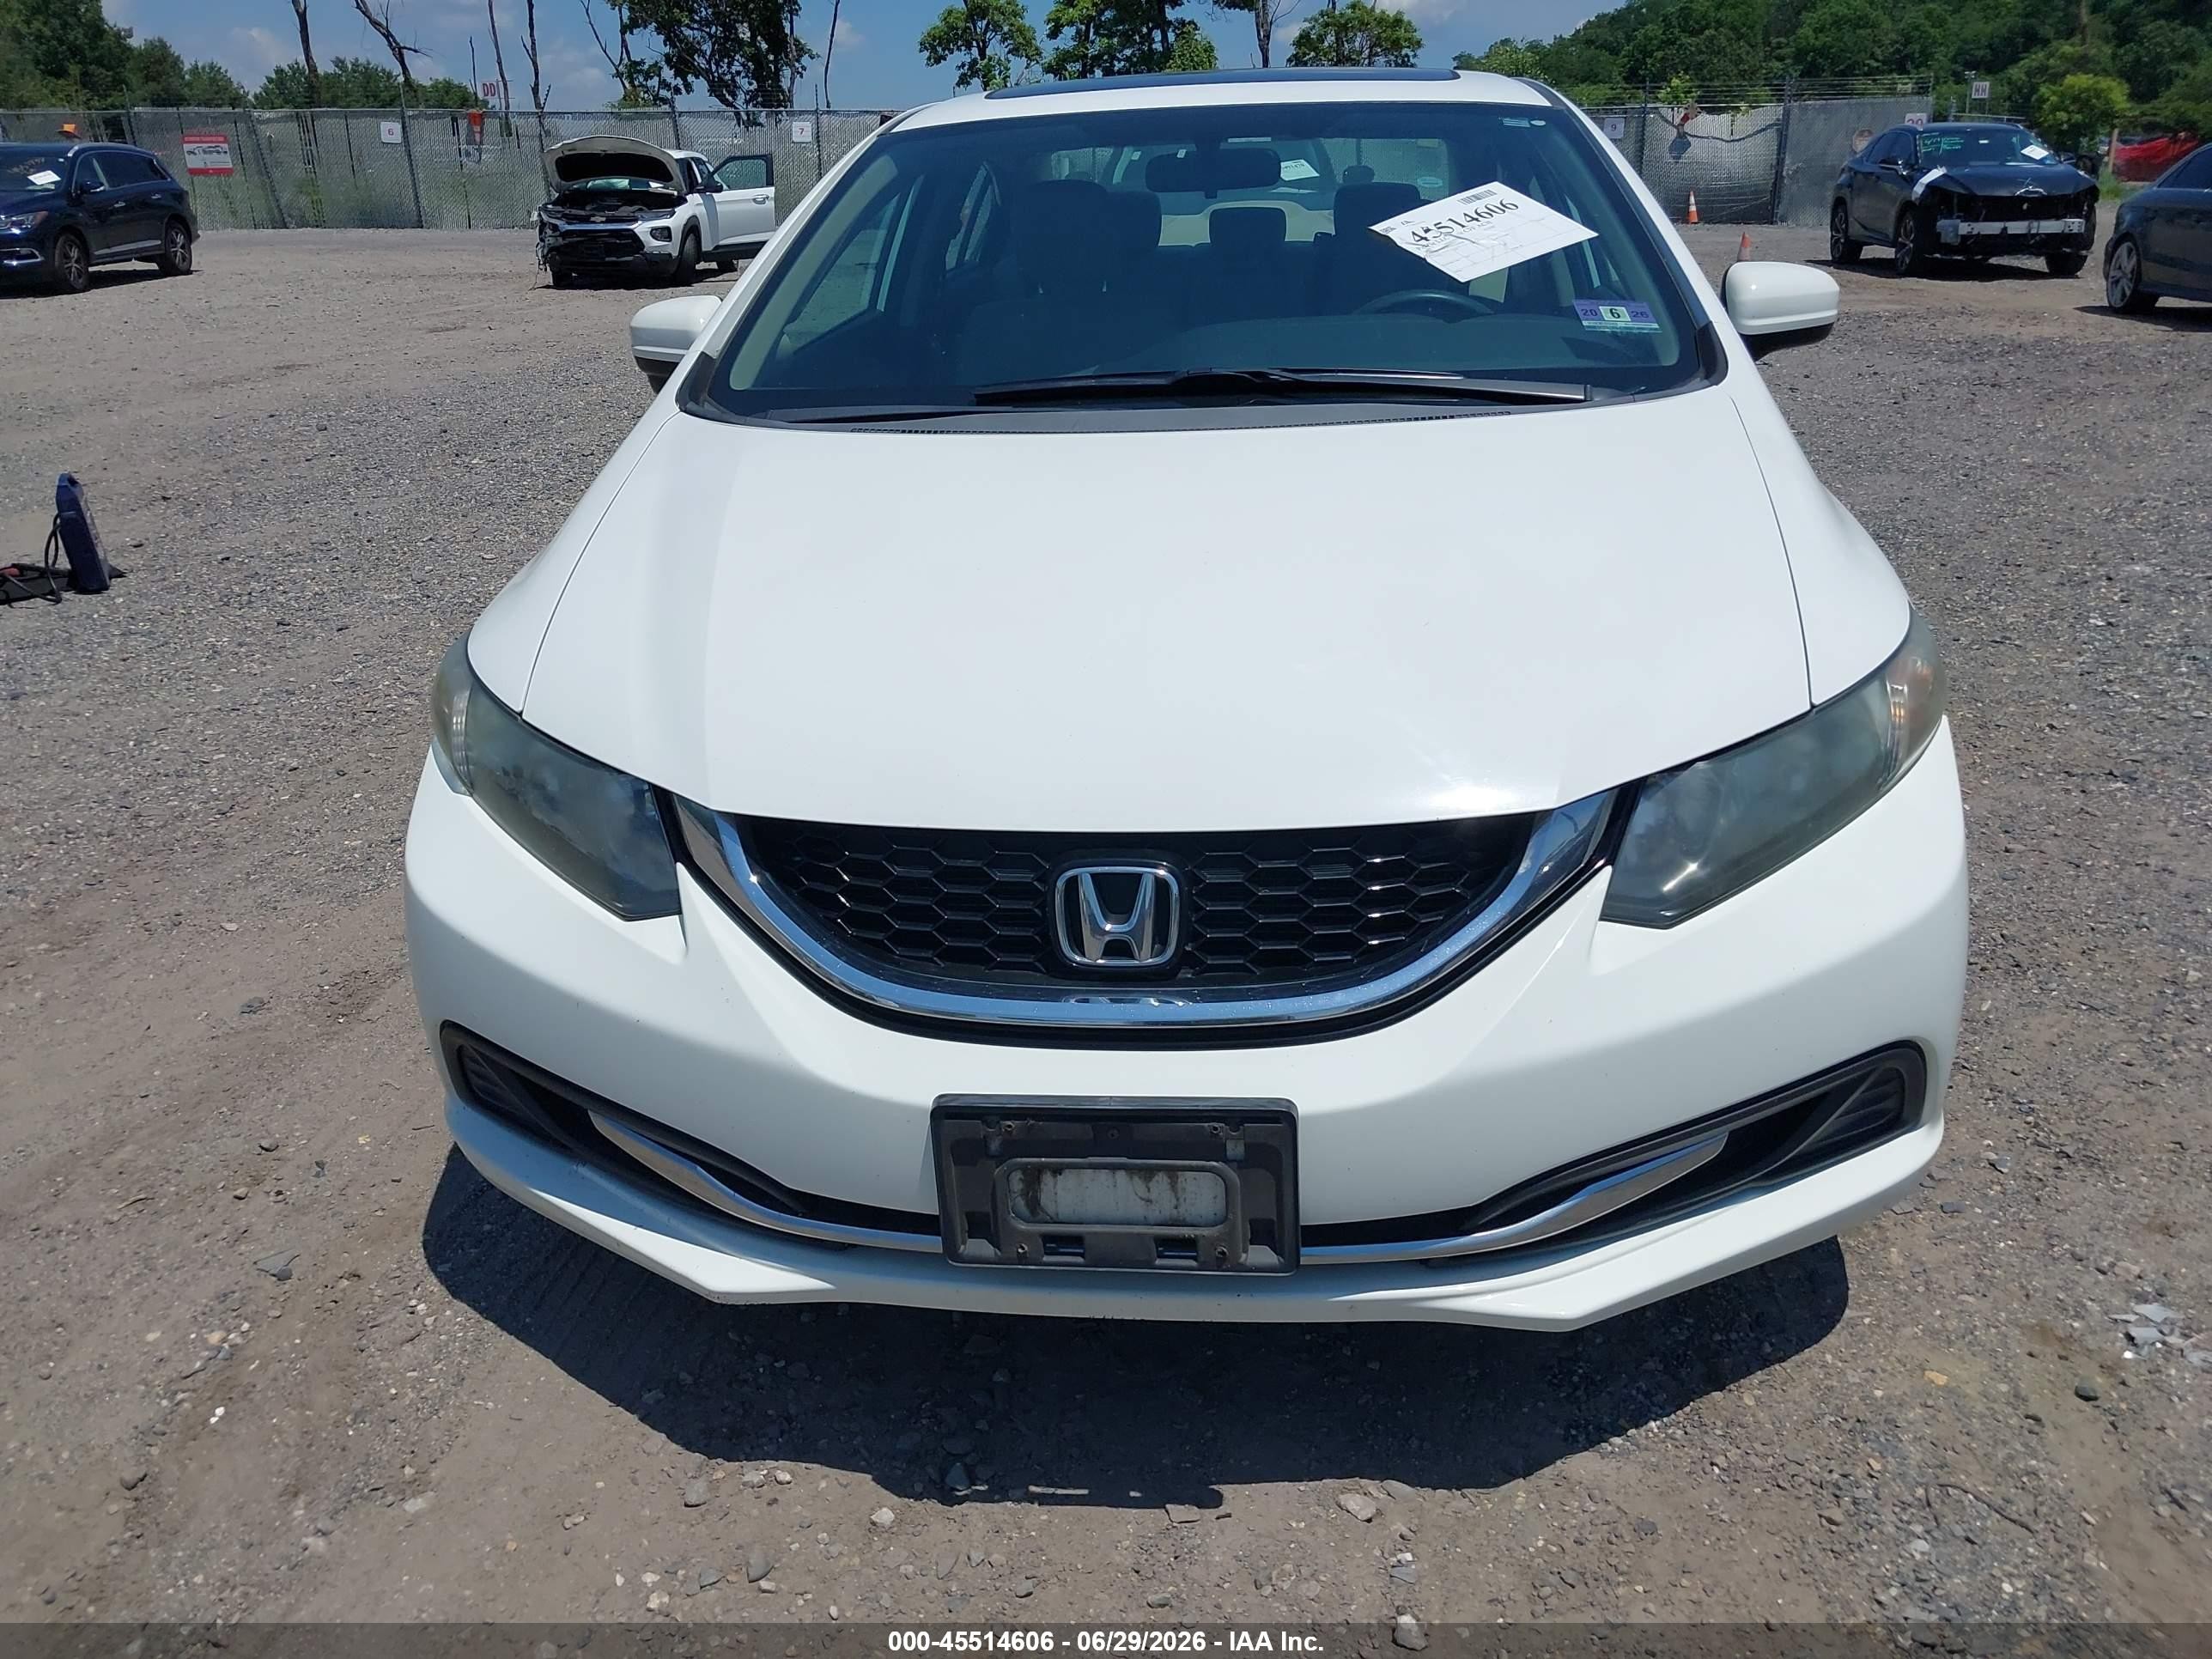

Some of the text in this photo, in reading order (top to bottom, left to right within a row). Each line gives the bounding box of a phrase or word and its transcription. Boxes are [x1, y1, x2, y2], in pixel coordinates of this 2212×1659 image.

[482, 82, 496, 97] DD
[1973, 83, 1987, 96] HH
[1580, 307, 1650, 319] 20 6 26
